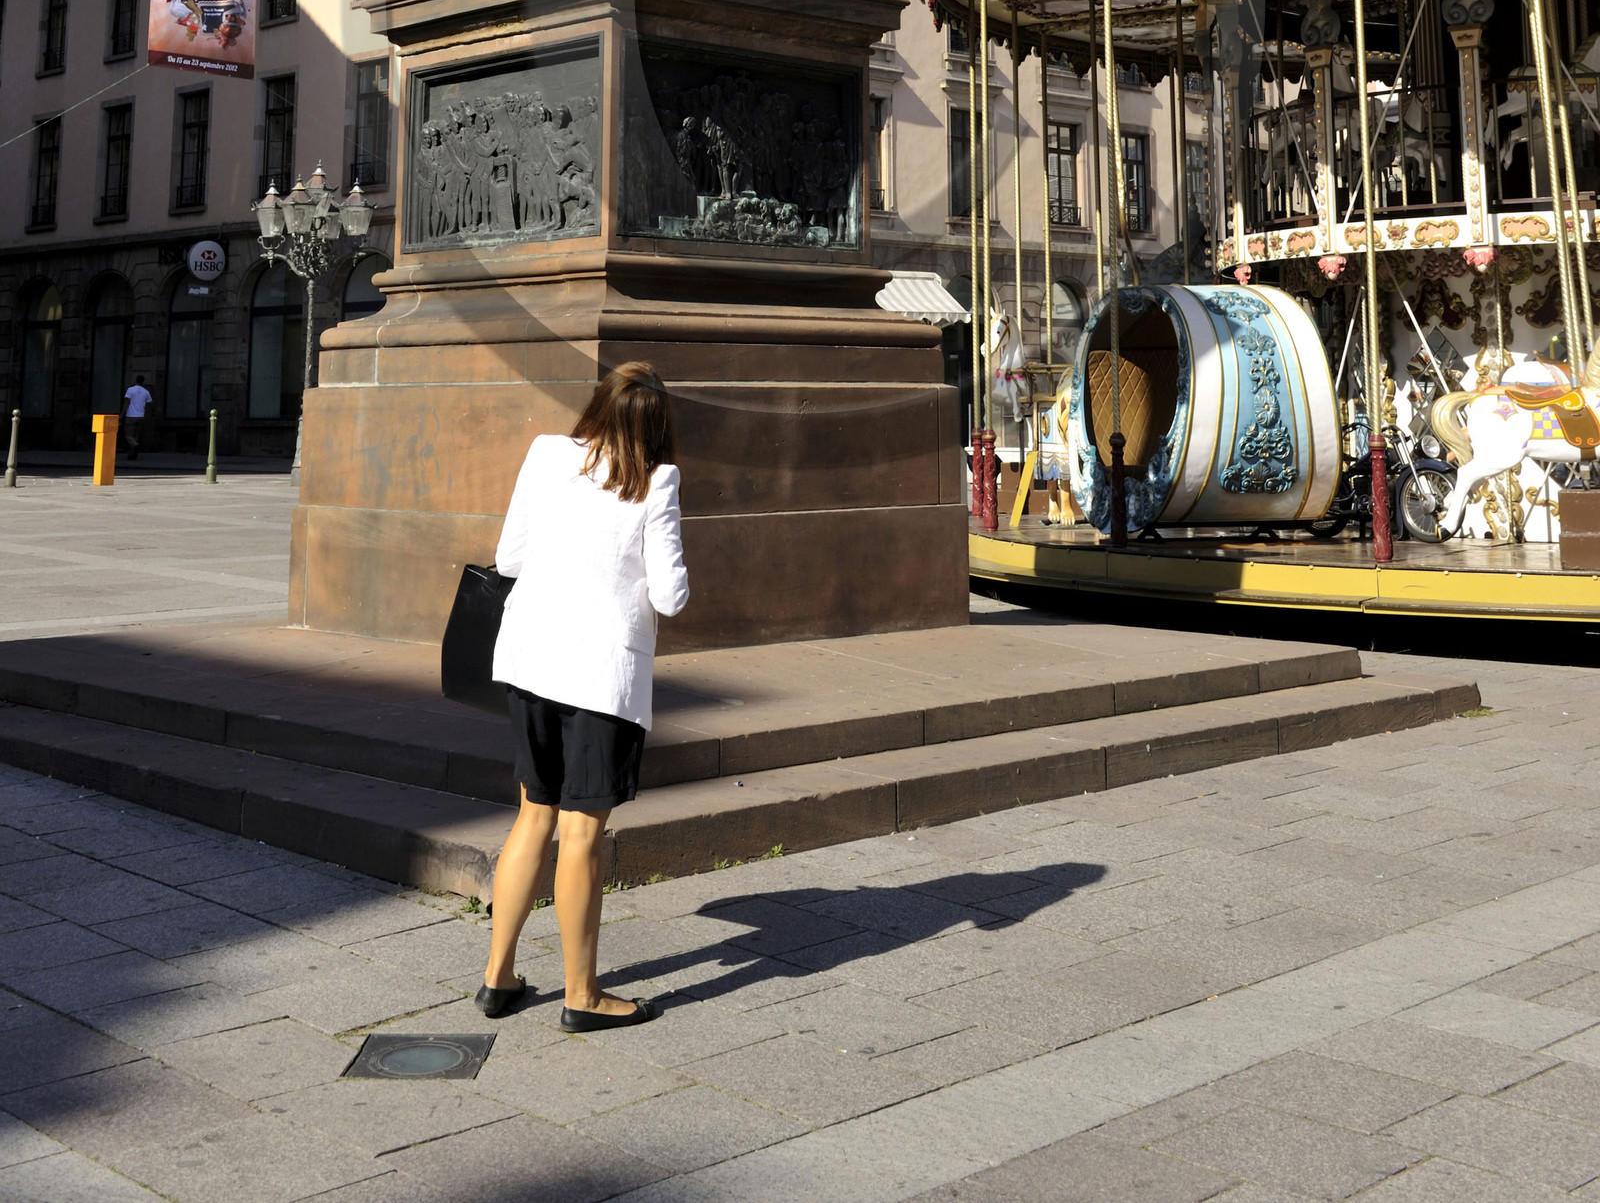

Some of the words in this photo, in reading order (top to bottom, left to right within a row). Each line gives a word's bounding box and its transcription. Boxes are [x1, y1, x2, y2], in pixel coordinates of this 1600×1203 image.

[167, 55, 176, 63] Du
[176, 56, 183, 64] 15
[191, 58, 199, 66] 23
[199, 61, 225, 70] septembre
[225, 64, 238, 72] 2012
[193, 261, 224, 272] HSBC
